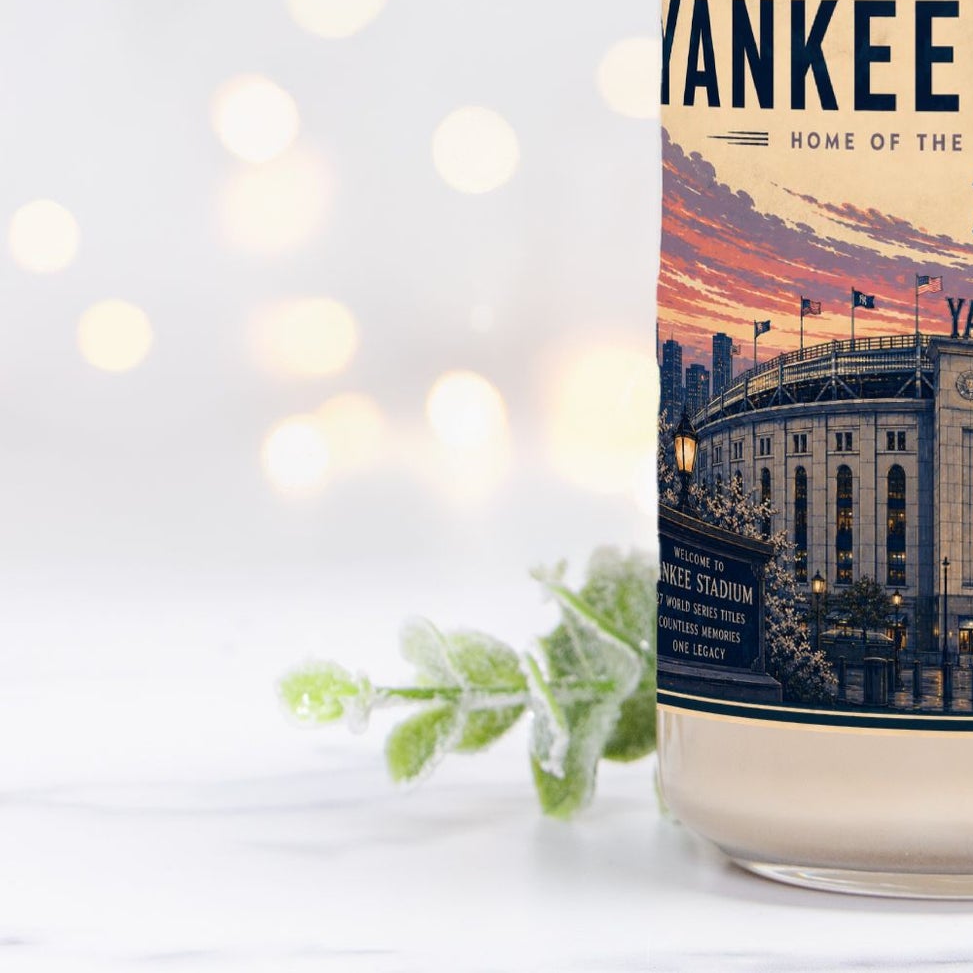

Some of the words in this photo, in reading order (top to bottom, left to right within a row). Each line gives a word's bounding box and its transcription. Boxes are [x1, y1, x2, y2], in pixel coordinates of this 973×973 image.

[791, 131, 855, 151] HOME
[870, 132, 900, 151] OF
[916, 133, 963, 152] THE
[673, 546, 711, 569] WELCOME
[714, 559, 724, 573] TO
[660, 561, 692, 590] NKEE
[696, 572, 753, 606] STADIUM
[665, 594, 691, 613] WORLD
[693, 602, 718, 619] SERIES
[720, 609, 746, 625] TITLES
[658, 615, 699, 636] COUNTLESS
[701, 625, 741, 644] MEMORIES
[672, 639, 689, 654] ONE
[693, 644, 726, 659] LEGACY
